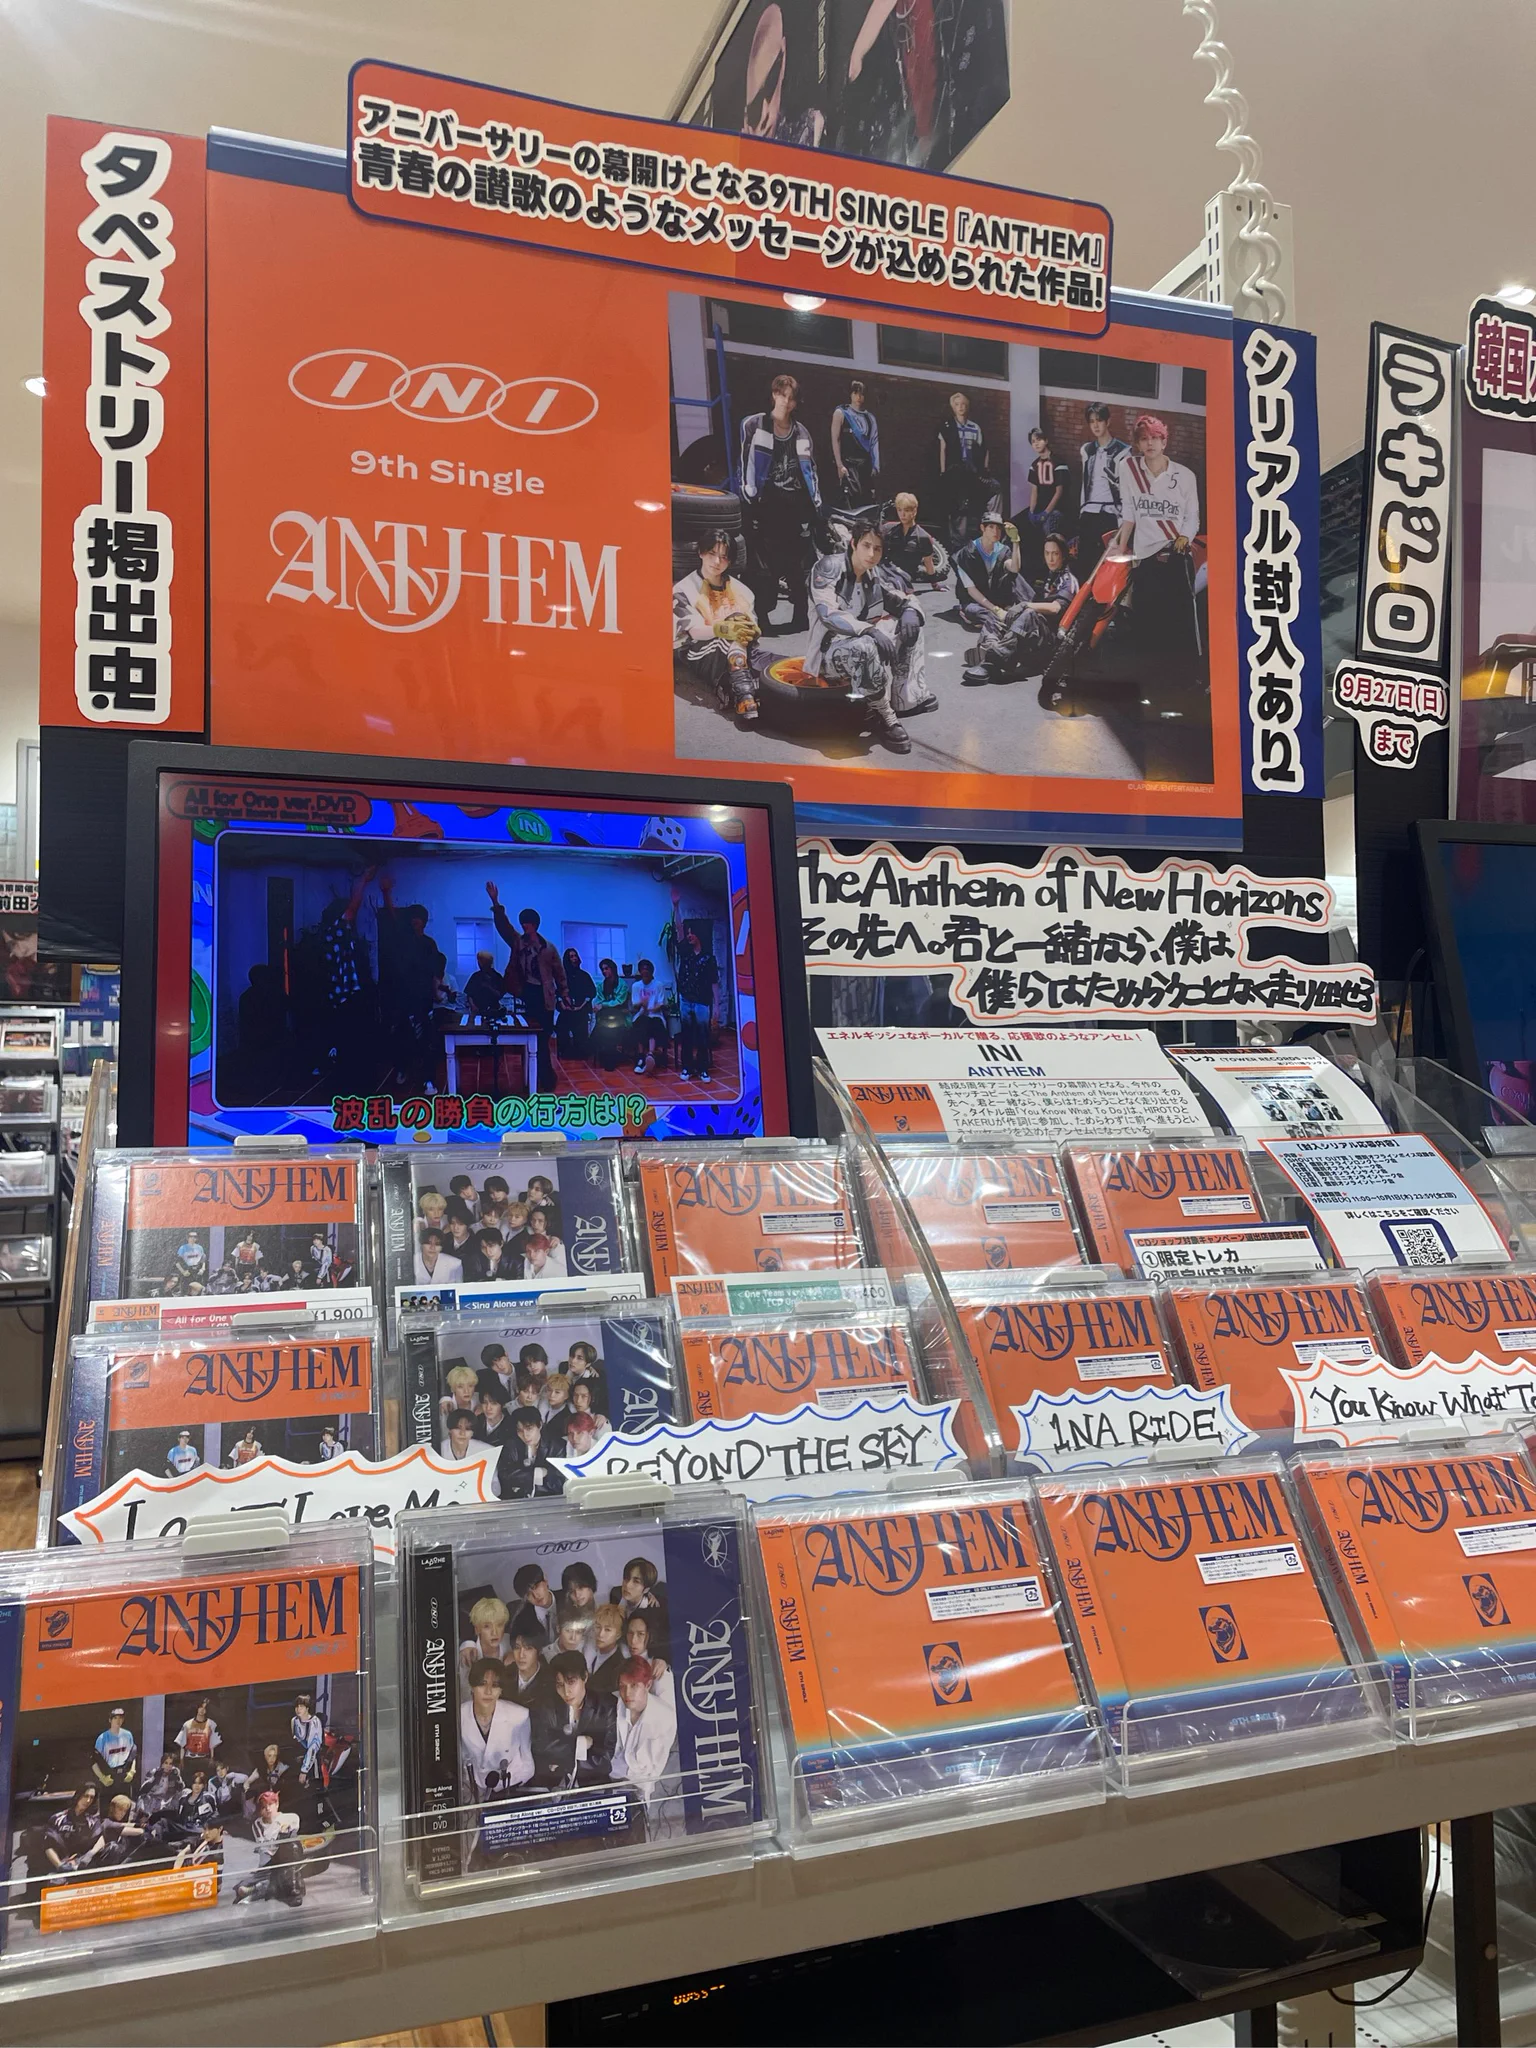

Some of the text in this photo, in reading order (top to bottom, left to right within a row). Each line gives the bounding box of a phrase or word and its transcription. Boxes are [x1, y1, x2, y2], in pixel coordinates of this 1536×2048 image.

[360, 99, 1103, 269] アニバーサリーの幕開けとなる9TH SINGLE 『ANTHEM』
[1475, 316, 1536, 400] 韓国
[308, 355, 577, 429] INI
[349, 449, 546, 497] 9th Single
[1036, 460, 1055, 486] 10
[1167, 471, 1179, 490] 5
[1367, 342, 1446, 656] ラキドロ
[266, 510, 624, 634] ANTHEM
[1248, 337, 1297, 783] シリアル封入あり
[1341, 676, 1447, 720] 9月27日(日)
[1375, 726, 1413, 758] まで
[519, 817, 545, 837] INI
[1035, 856, 1077, 908] of
[1082, 870, 1164, 913] New
[1168, 870, 1322, 922] Horizons
[966, 1065, 1047, 1078] ANTHEM
[976, 1043, 1023, 1062] INI
[331, 1093, 649, 1132] 波乱の勝負の行方は!?
[1041, 1108, 1067, 1116] Know
[1068, 1107, 1091, 1115] What
[1094, 1107, 1107, 1115] To
[192, 1165, 349, 1212] ANTHEM
[1103, 1151, 1245, 1201] ANTHEM
[190, 1315, 207, 1323] for
[983, 1300, 1156, 1362] ANTHEM
[1204, 1286, 1364, 1347] ANTHEM
[183, 1344, 361, 1403] ANTHEM
[719, 1332, 903, 1395] ANTHEM
[1128, 1406, 1225, 1448] RIDE
[1309, 1383, 1369, 1426] You
[1367, 1386, 1438, 1422] Know
[1438, 1383, 1506, 1419] What
[73, 1419, 96, 1478] ANTHEM
[765, 1434, 854, 1481] THE
[857, 1422, 931, 1471] SKY
[1082, 1478, 1289, 1563] ANTHEM
[1346, 1459, 1536, 1534] ANTHEM
[535, 1539, 590, 1556] INI
[803, 1505, 1032, 1597] ANTHEM
[1336, 1529, 1369, 1586] ANTHEM
[1066, 1557, 1097, 1618] ANTHEM
[116, 1574, 347, 1664] ANTHEM
[778, 1597, 807, 1663] ANTHEM
[421, 1637, 447, 1715] ANTHEM
[681, 1618, 748, 1823] ANTHEM
[432, 1820, 448, 1831] DVD
